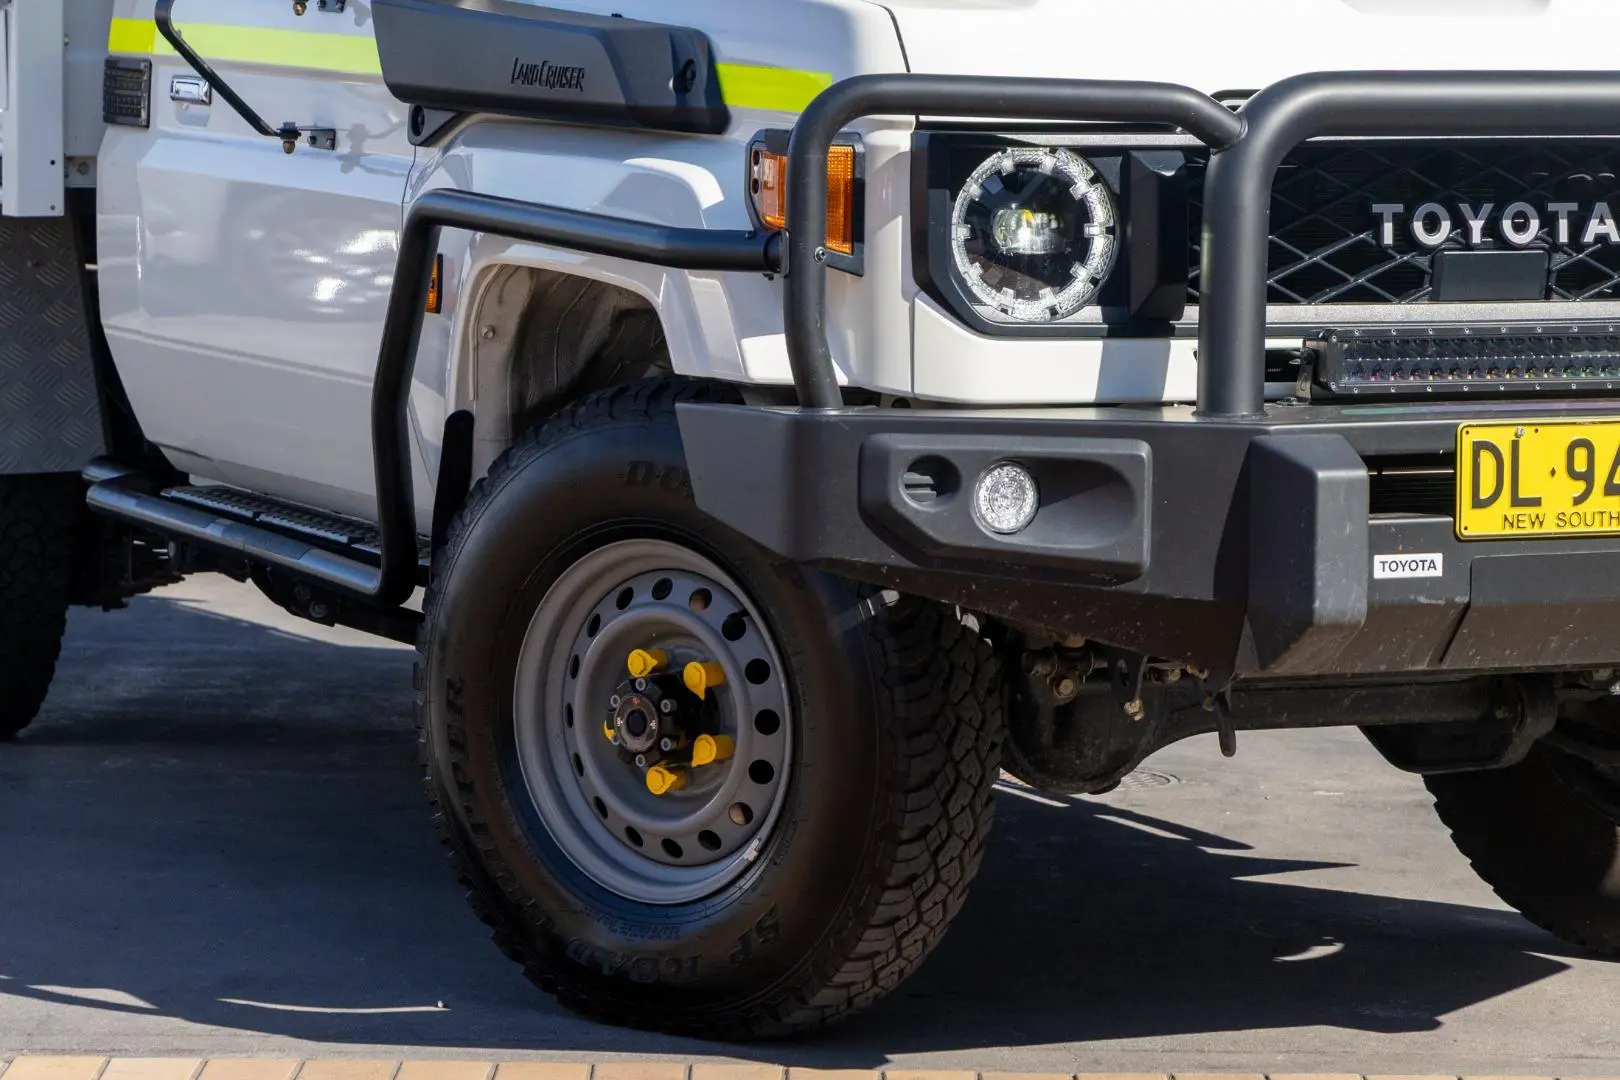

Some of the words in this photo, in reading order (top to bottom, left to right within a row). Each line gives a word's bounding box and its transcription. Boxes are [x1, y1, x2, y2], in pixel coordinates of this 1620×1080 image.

[1371, 201, 1620, 245] TOYOTA
[1503, 513, 1545, 529] NEW
[1556, 510, 1620, 528] SOUTH
[1379, 559, 1437, 573] TOYOTA
